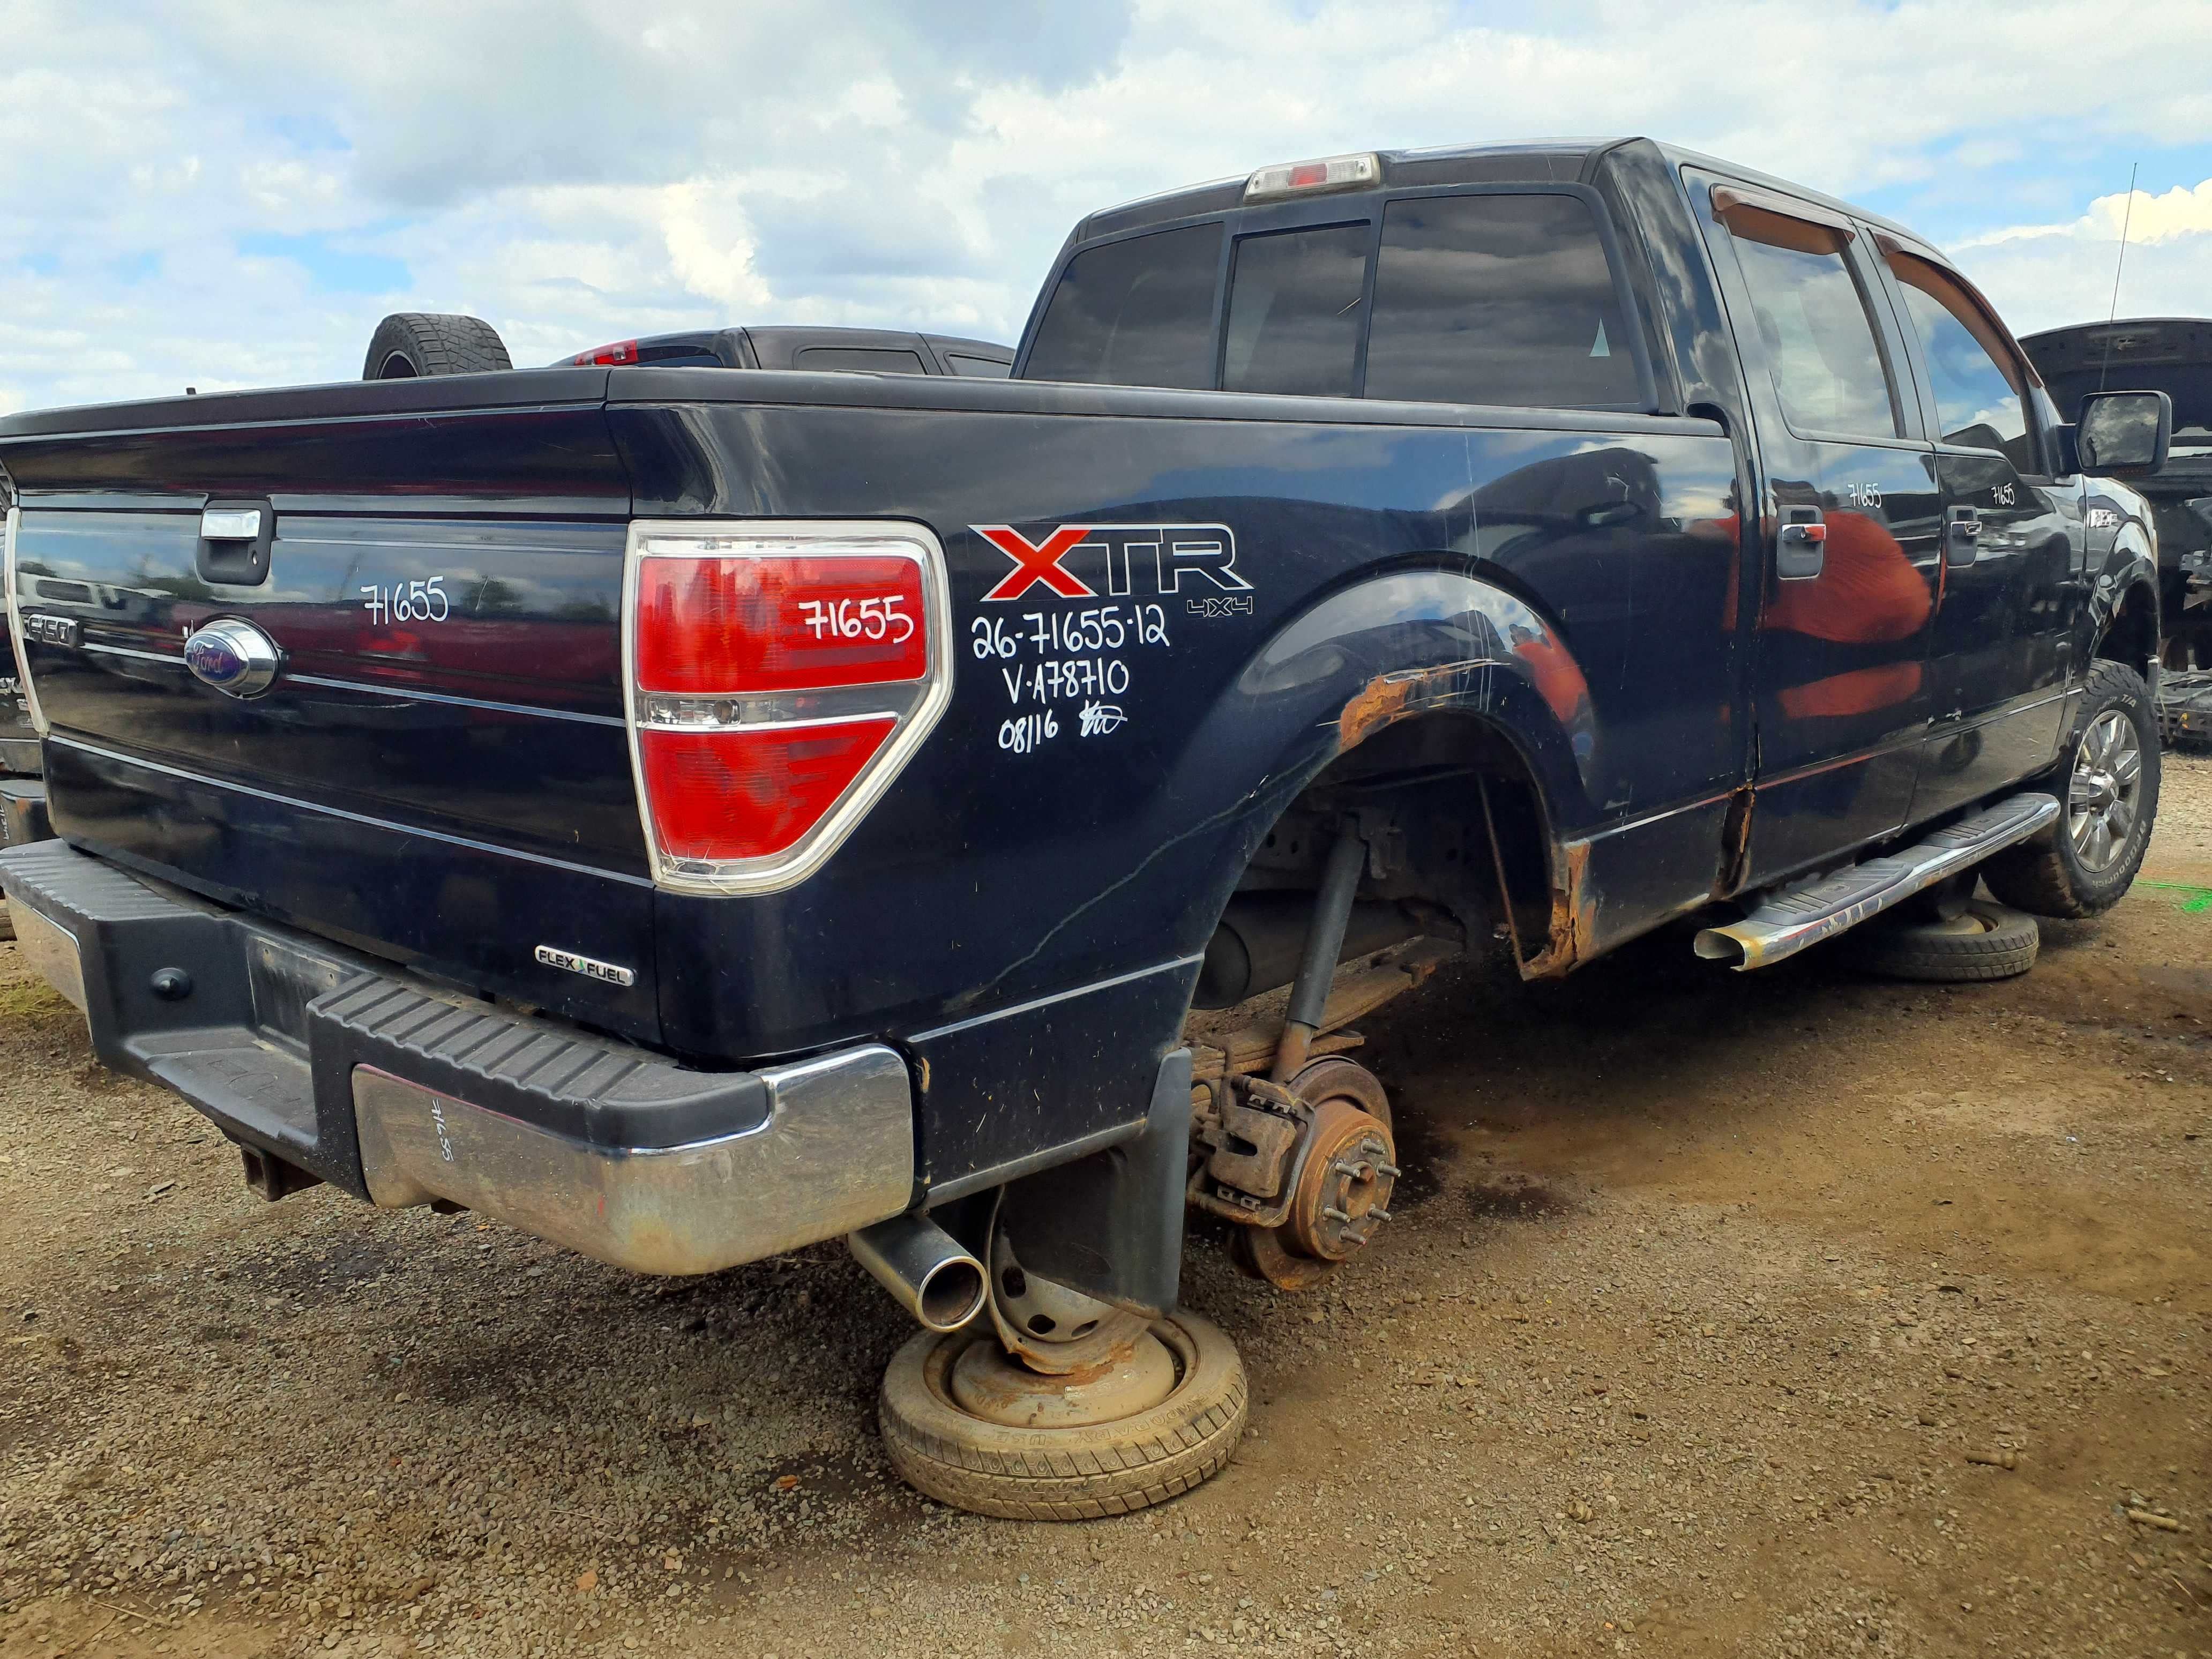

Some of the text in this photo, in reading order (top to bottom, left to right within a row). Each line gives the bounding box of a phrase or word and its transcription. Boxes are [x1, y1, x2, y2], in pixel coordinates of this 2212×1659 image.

[1847, 483, 1882, 509] 71655
[1991, 483, 2015, 505] 71655
[967, 524, 1255, 601] XTR
[360, 576, 449, 626] 71655
[798, 595, 914, 644] 71655
[192, 640, 224, 674] Ford
[998, 708, 1058, 753] 08/16
[539, 950, 626, 984] FLEX FUEL
[431, 1098, 454, 1162] 71655
